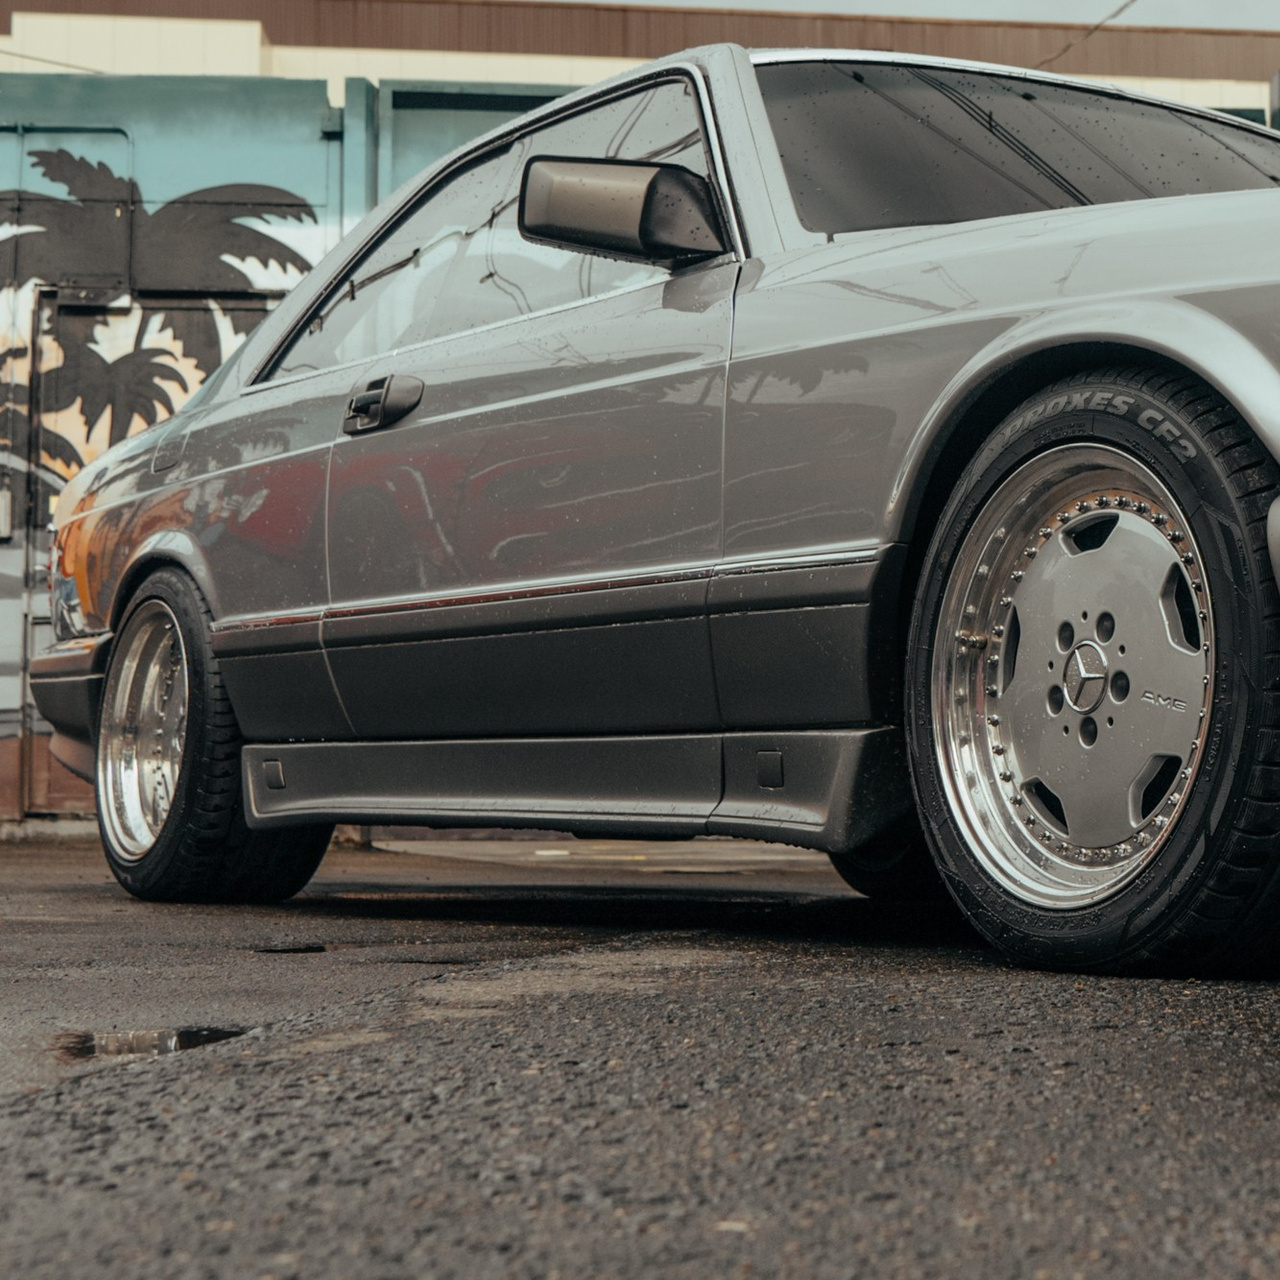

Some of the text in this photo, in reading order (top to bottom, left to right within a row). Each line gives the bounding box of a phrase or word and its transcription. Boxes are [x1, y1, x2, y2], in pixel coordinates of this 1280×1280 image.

[999, 391, 1135, 446] PROXES
[1137, 409, 1198, 464] CF2
[1141, 690, 1188, 713] AMG
